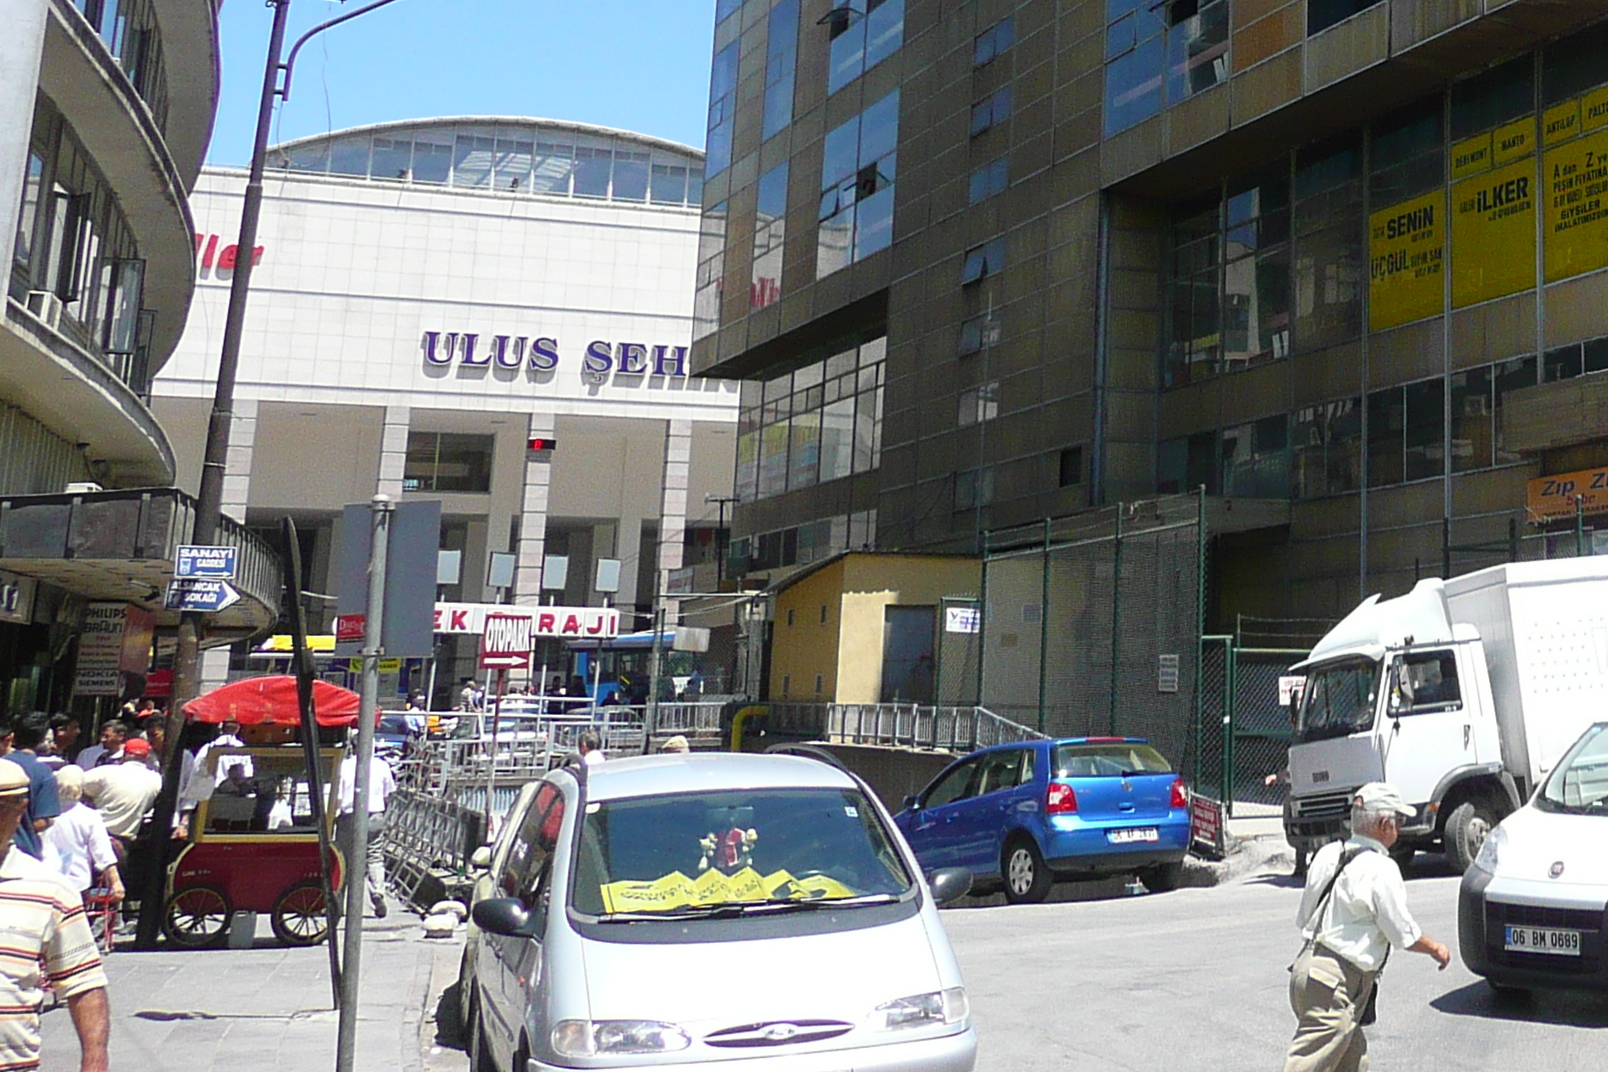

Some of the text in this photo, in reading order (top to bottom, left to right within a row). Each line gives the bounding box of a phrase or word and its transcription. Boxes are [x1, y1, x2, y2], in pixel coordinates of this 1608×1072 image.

[1553, 164, 1560, 180] A
[1586, 152, 1594, 168] Z
[1476, 177, 1529, 213] İLKER
[1386, 205, 1434, 240] SENİN
[424, 330, 690, 383] ULUS ŞEH
[1566, 492, 1596, 506] bbe
[85, 607, 127, 619] PHILIPS
[84, 620, 123, 634] BRAUN
[485, 617, 532, 652] OTOPARK
[77, 670, 118, 678] NOKIA
[78, 679, 115, 687] SIEMENS
[1512, 929, 1526, 945] 06
